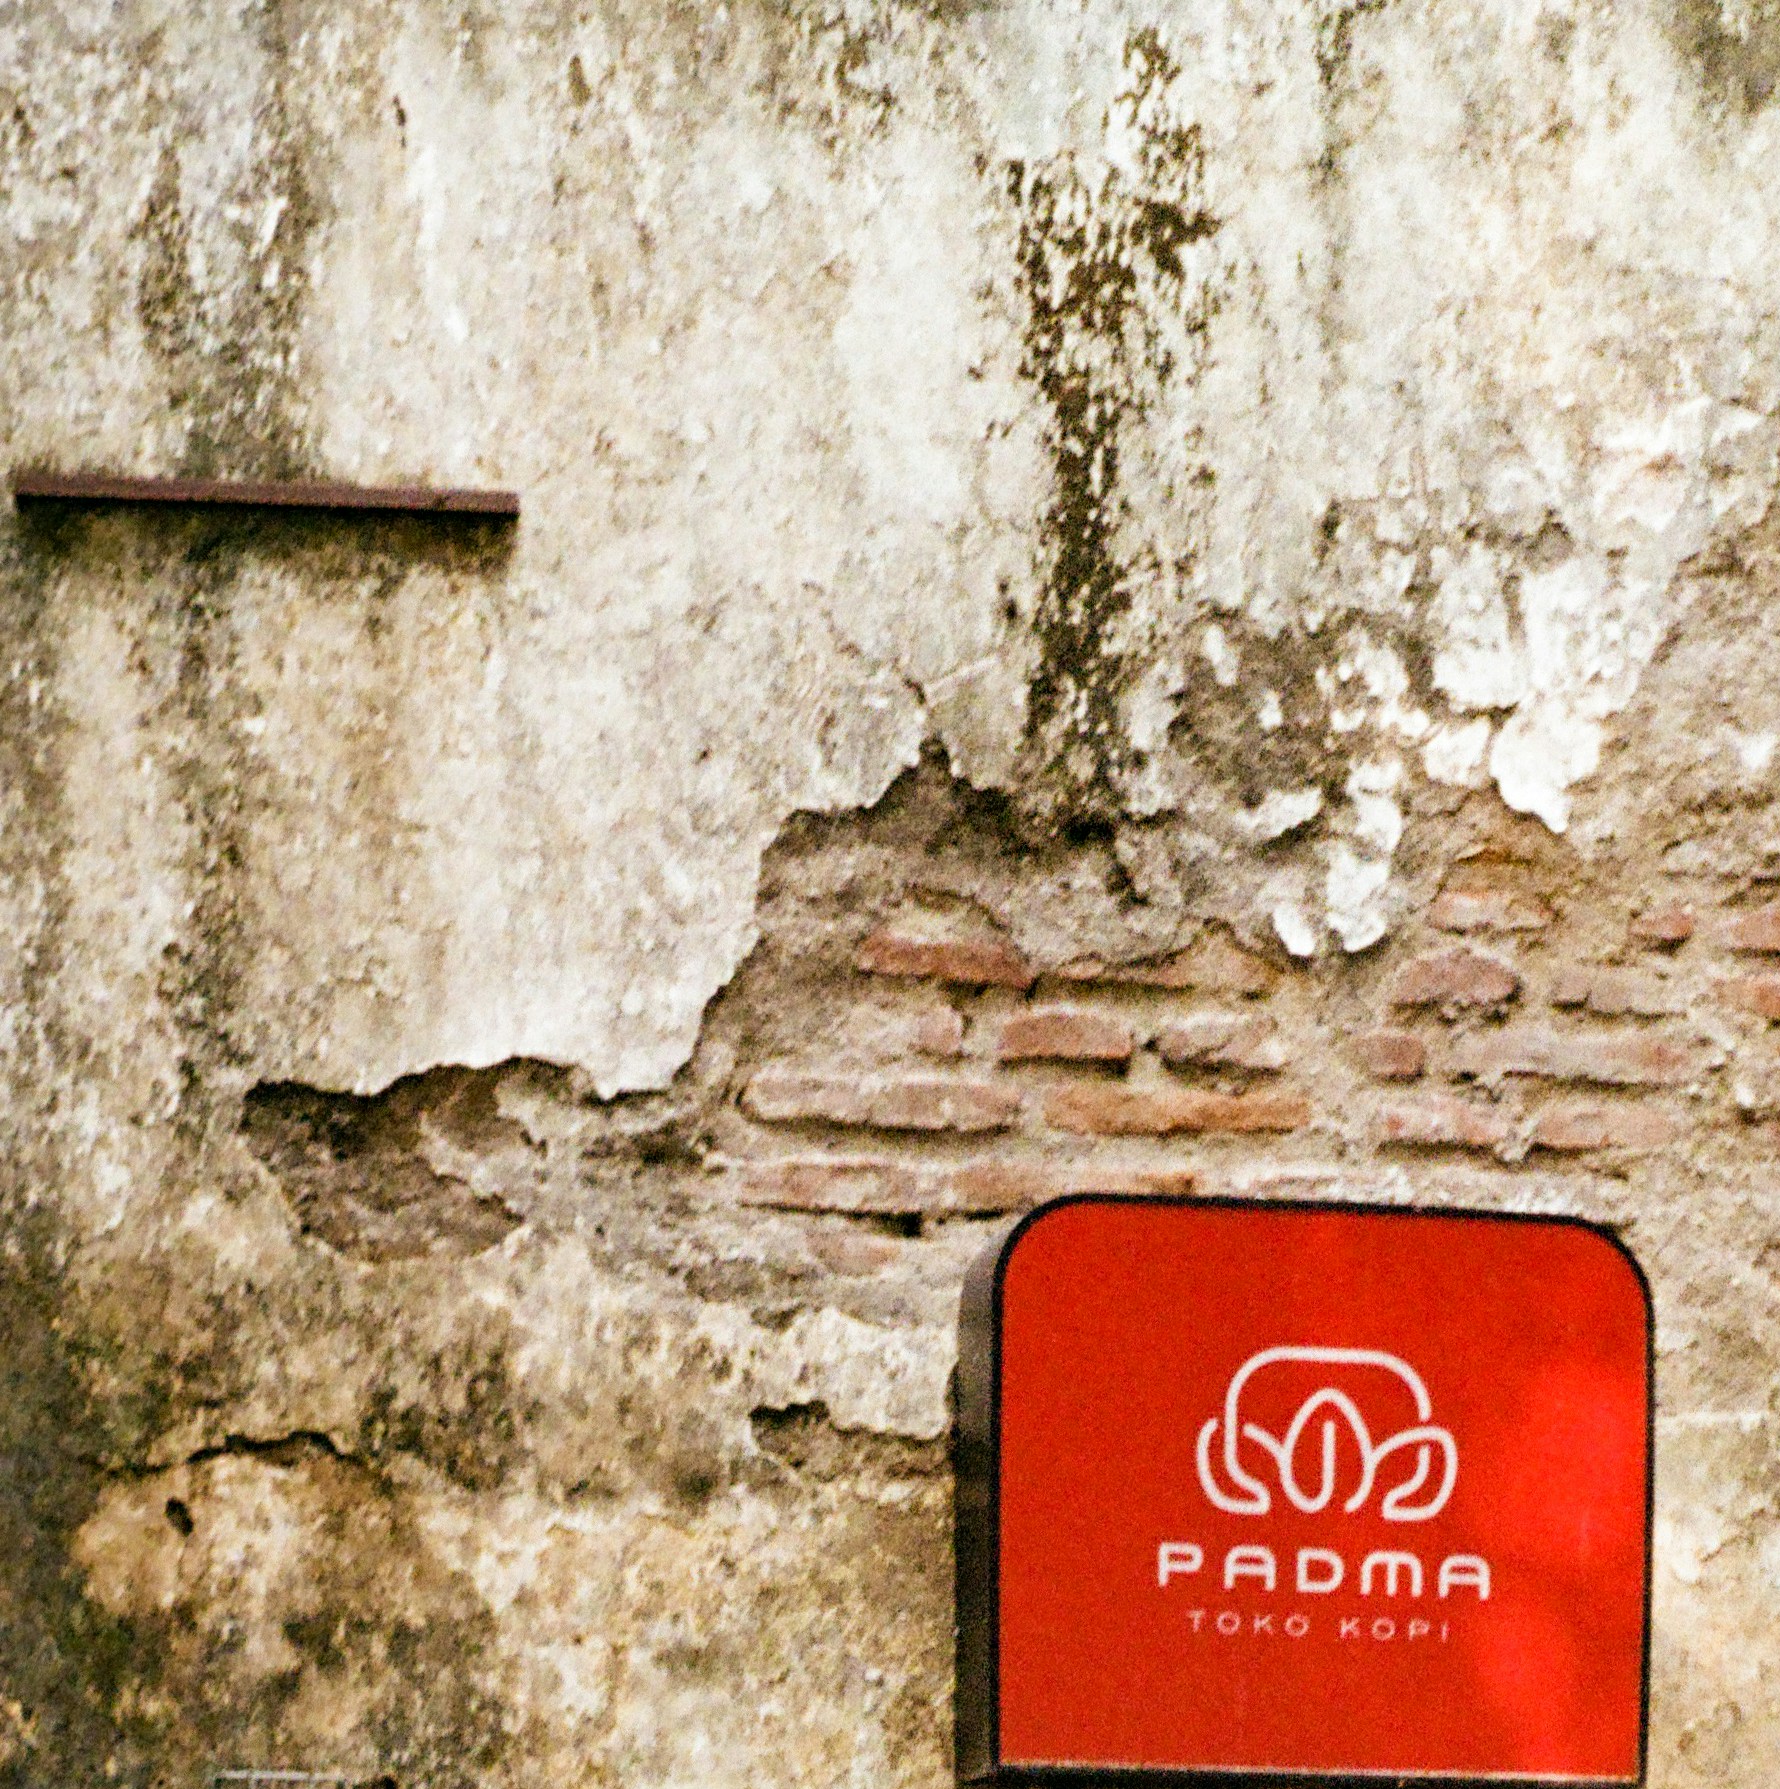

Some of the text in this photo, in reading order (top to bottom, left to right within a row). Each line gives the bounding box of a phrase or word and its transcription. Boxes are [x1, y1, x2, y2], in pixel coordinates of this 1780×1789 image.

[1157, 1541, 1491, 1600] PADMA
[1188, 1609, 1449, 1643] TOKO KOPI
